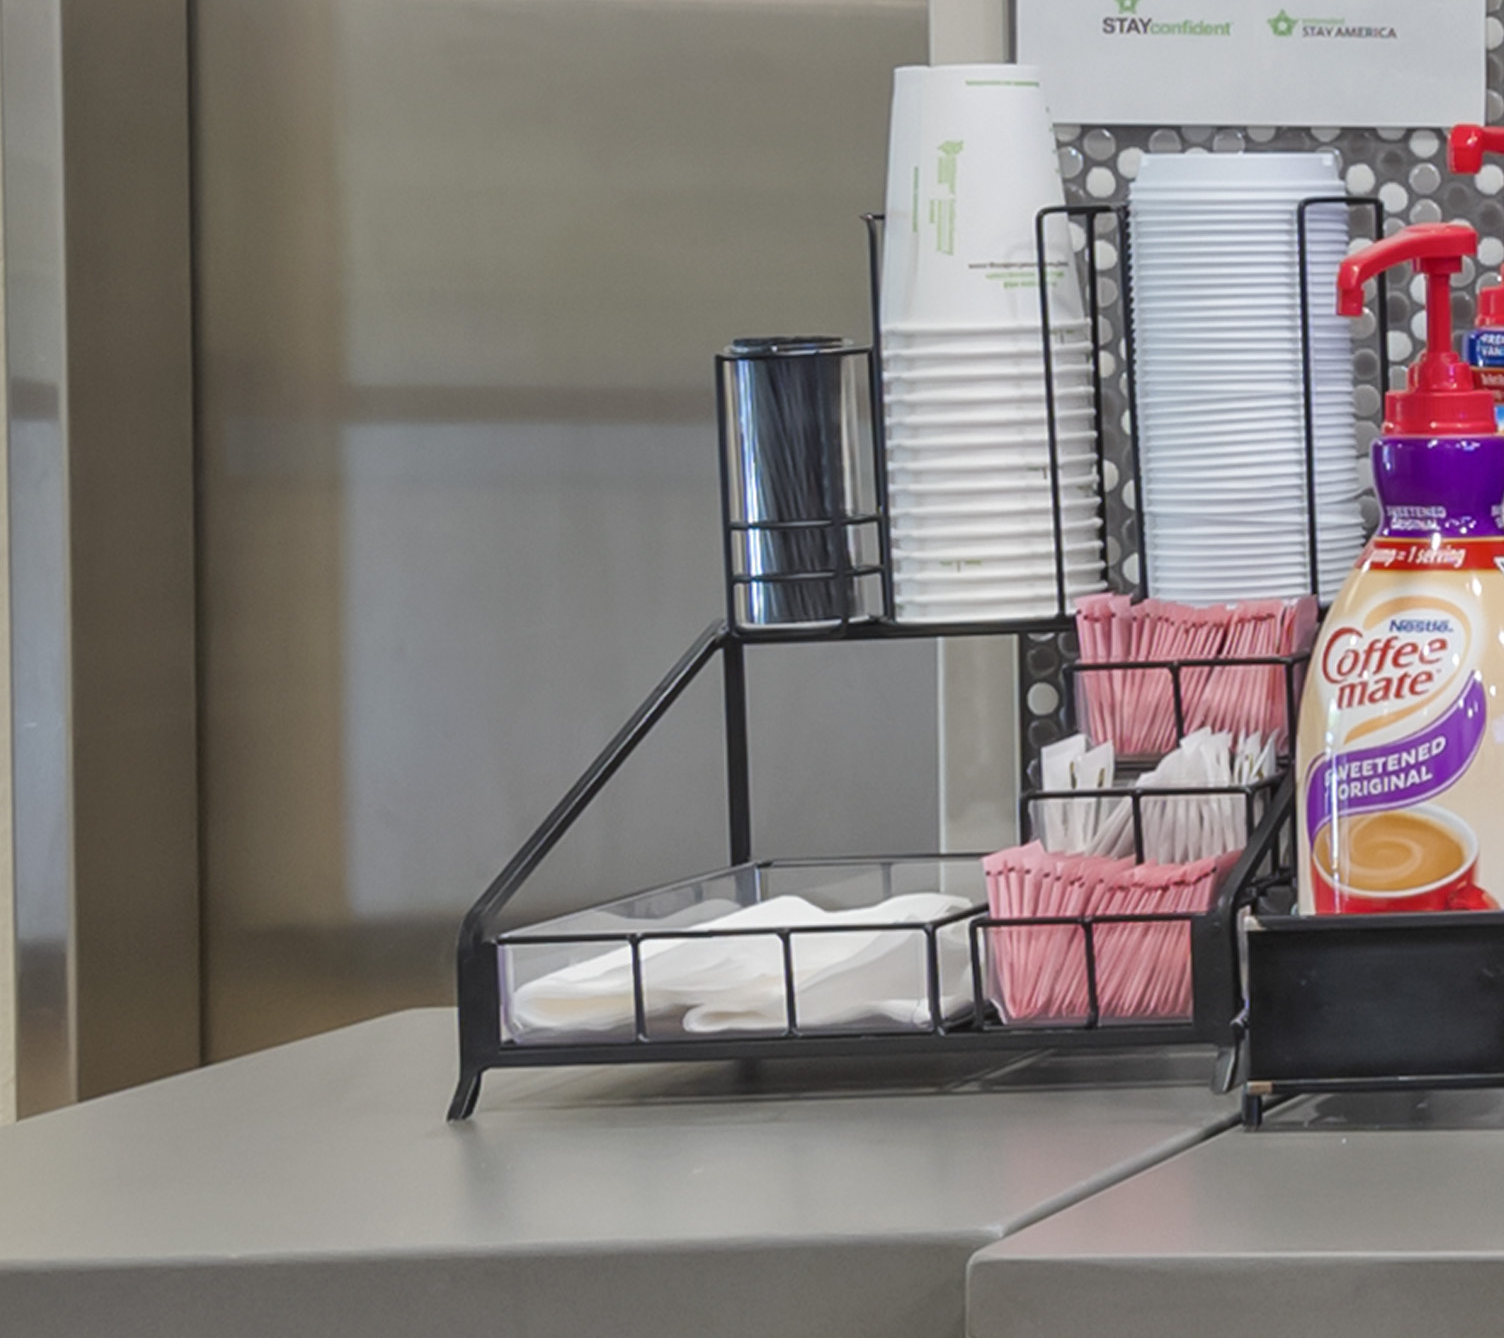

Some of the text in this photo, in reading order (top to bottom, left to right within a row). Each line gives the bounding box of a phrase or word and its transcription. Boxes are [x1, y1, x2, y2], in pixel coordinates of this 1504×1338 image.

[1334, 26, 1397, 39] AMERICA
[1416, 548, 1466, 568] serving
[1322, 627, 1448, 684] Coffee
[1338, 670, 1434, 710] mate
[1339, 766, 1433, 800] ORIGINAL
